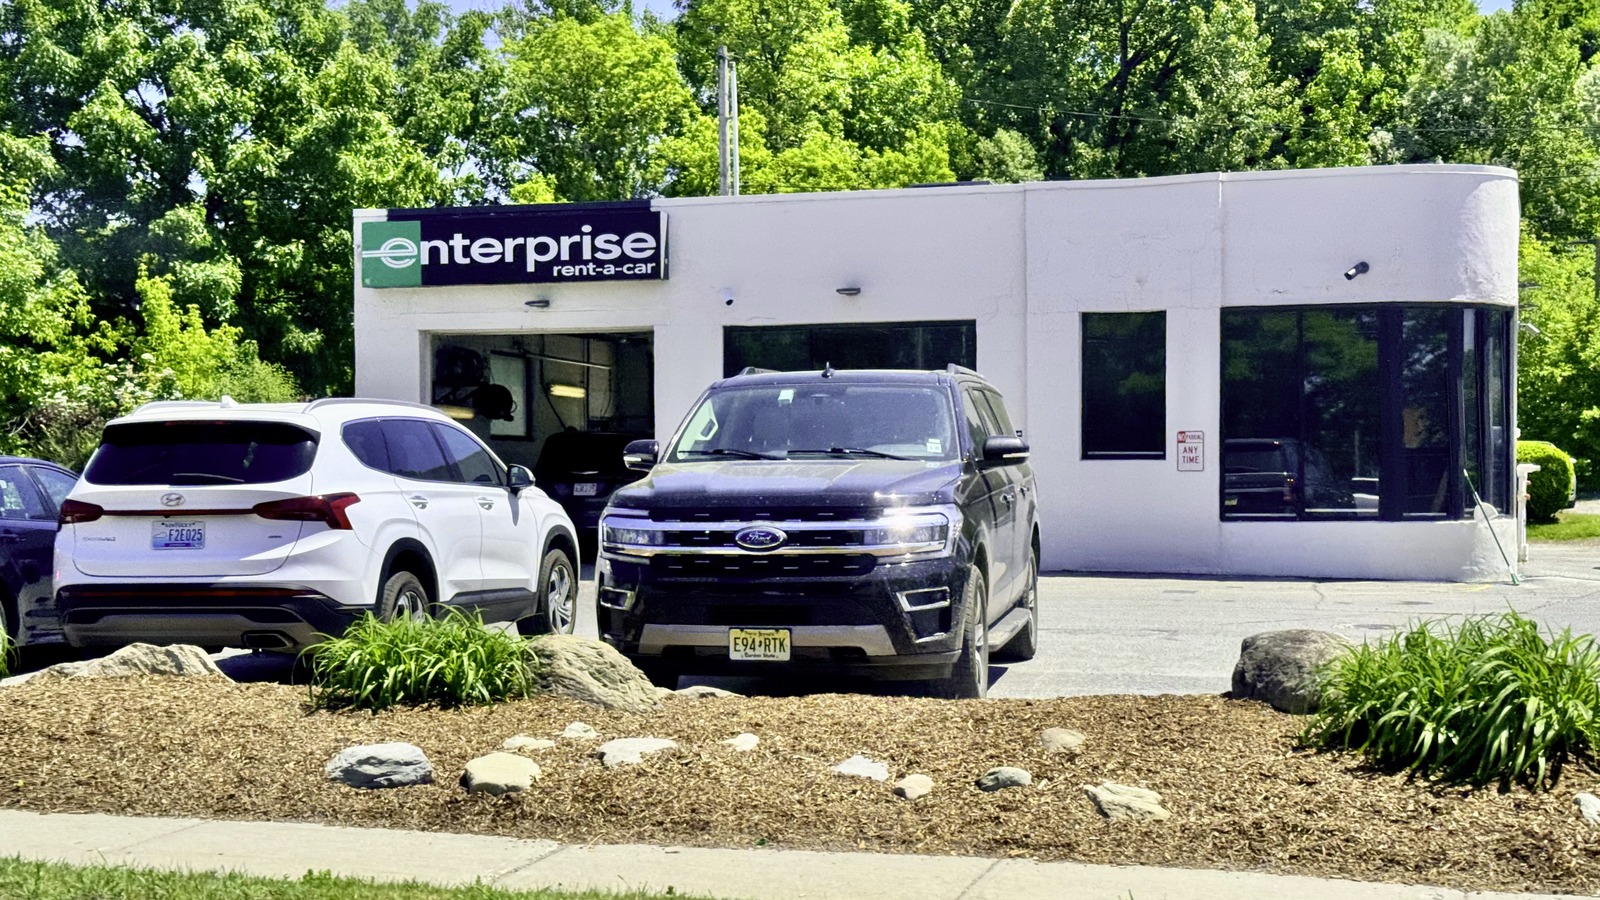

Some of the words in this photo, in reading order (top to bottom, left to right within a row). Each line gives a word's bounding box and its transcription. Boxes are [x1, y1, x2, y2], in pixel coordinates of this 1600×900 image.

[362, 225, 657, 272] enterprise
[553, 262, 656, 277] rent-a-car
[1183, 446, 1198, 455] ANY
[1182, 455, 1200, 464] TIME
[168, 529, 203, 542] F2E025
[746, 531, 773, 544] Ford
